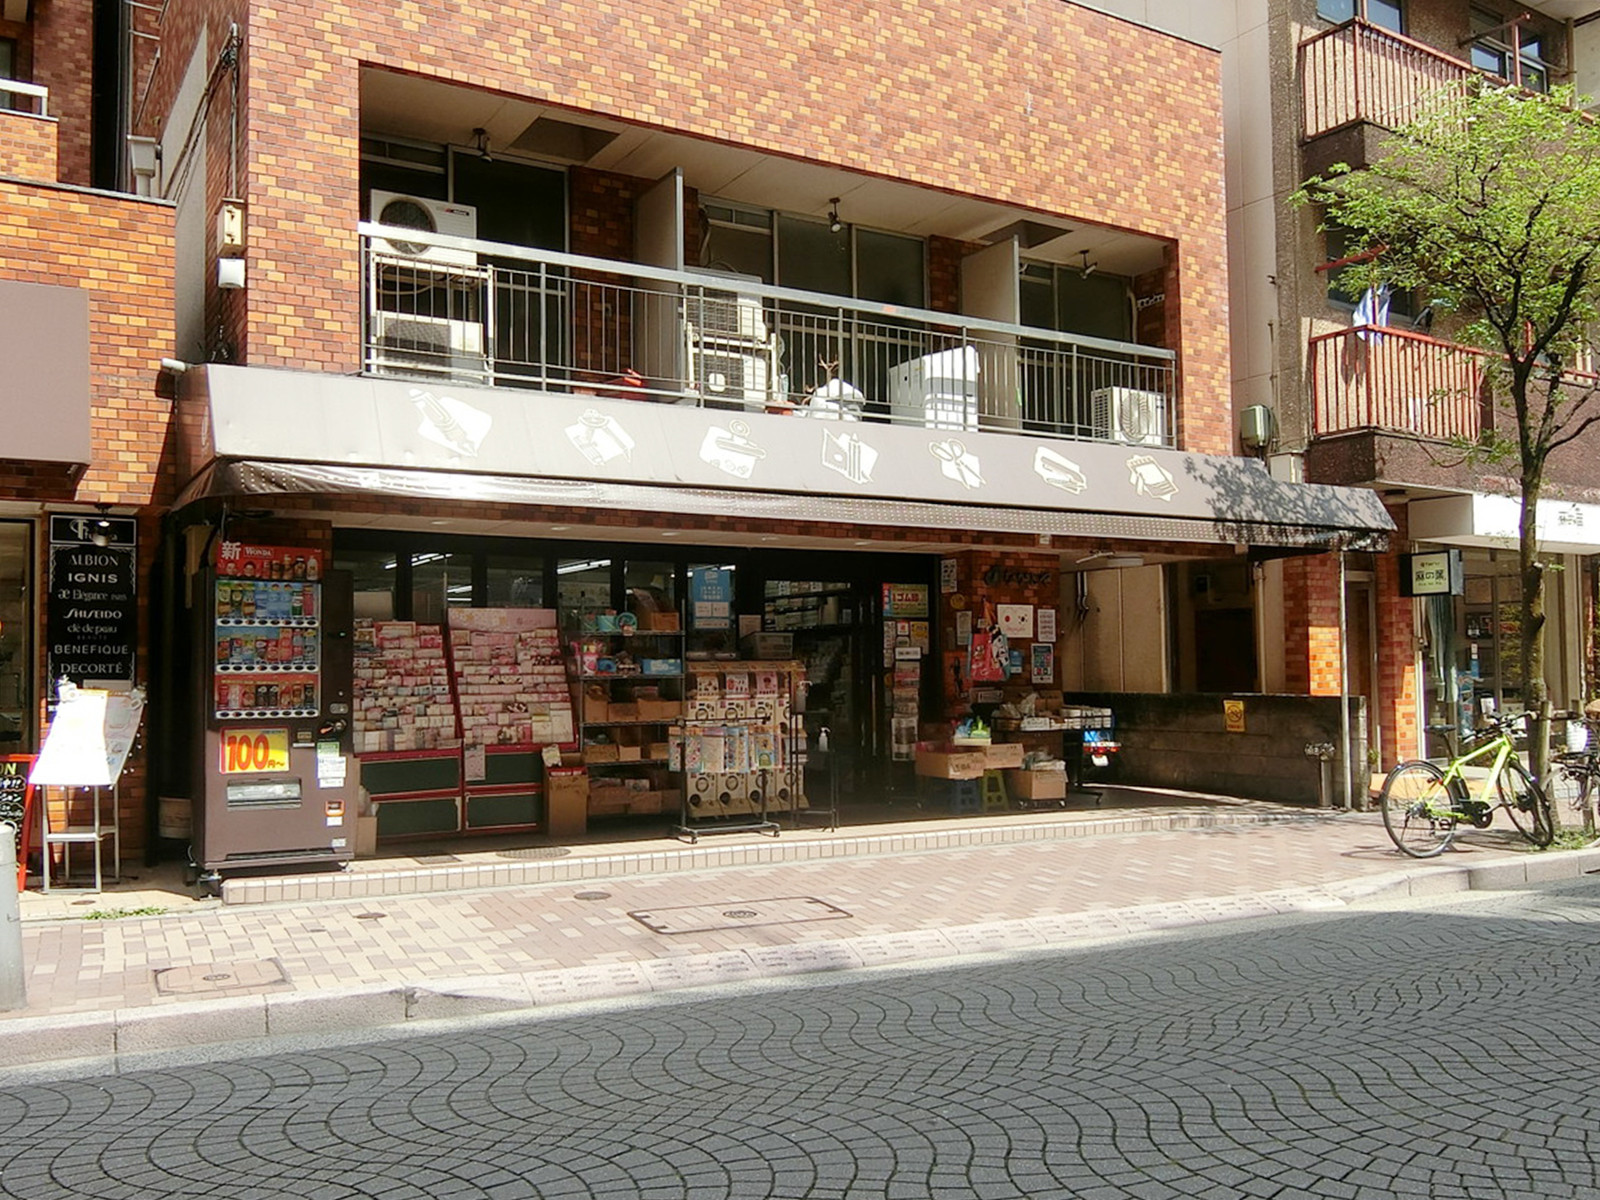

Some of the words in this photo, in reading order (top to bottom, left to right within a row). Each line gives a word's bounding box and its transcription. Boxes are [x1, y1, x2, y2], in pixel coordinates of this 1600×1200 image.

[222, 540, 241, 559] 新
[245, 547, 272, 556] WONDA
[70, 554, 119, 566] ALBION
[68, 573, 118, 583] IGNIS
[63, 607, 122, 619] SHISEIDO
[54, 644, 128, 654] BENEFIQUE
